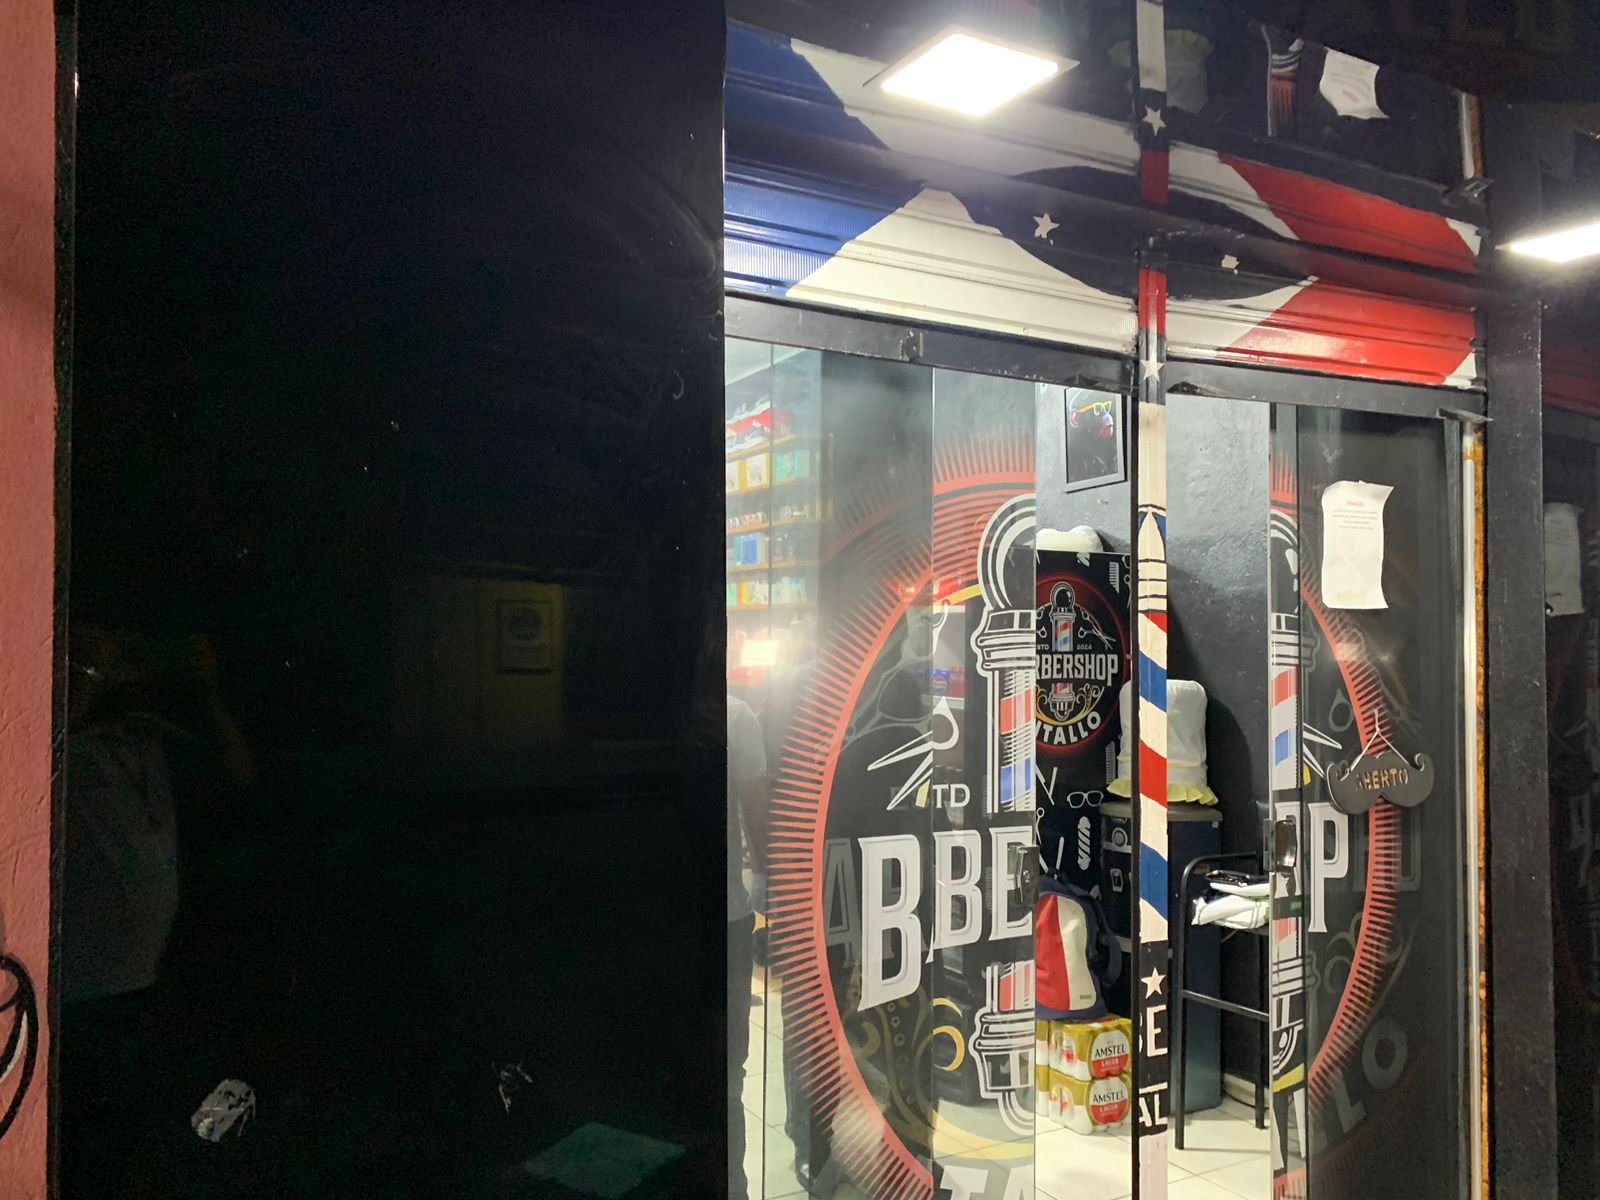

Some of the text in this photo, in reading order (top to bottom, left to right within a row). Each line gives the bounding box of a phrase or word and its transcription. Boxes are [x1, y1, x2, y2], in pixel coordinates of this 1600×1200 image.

[1094, 1043, 1127, 1058] AMSTEL
[1100, 1058, 1120, 1068] LAGER
[1093, 1089, 1125, 1104] AMSTEL
